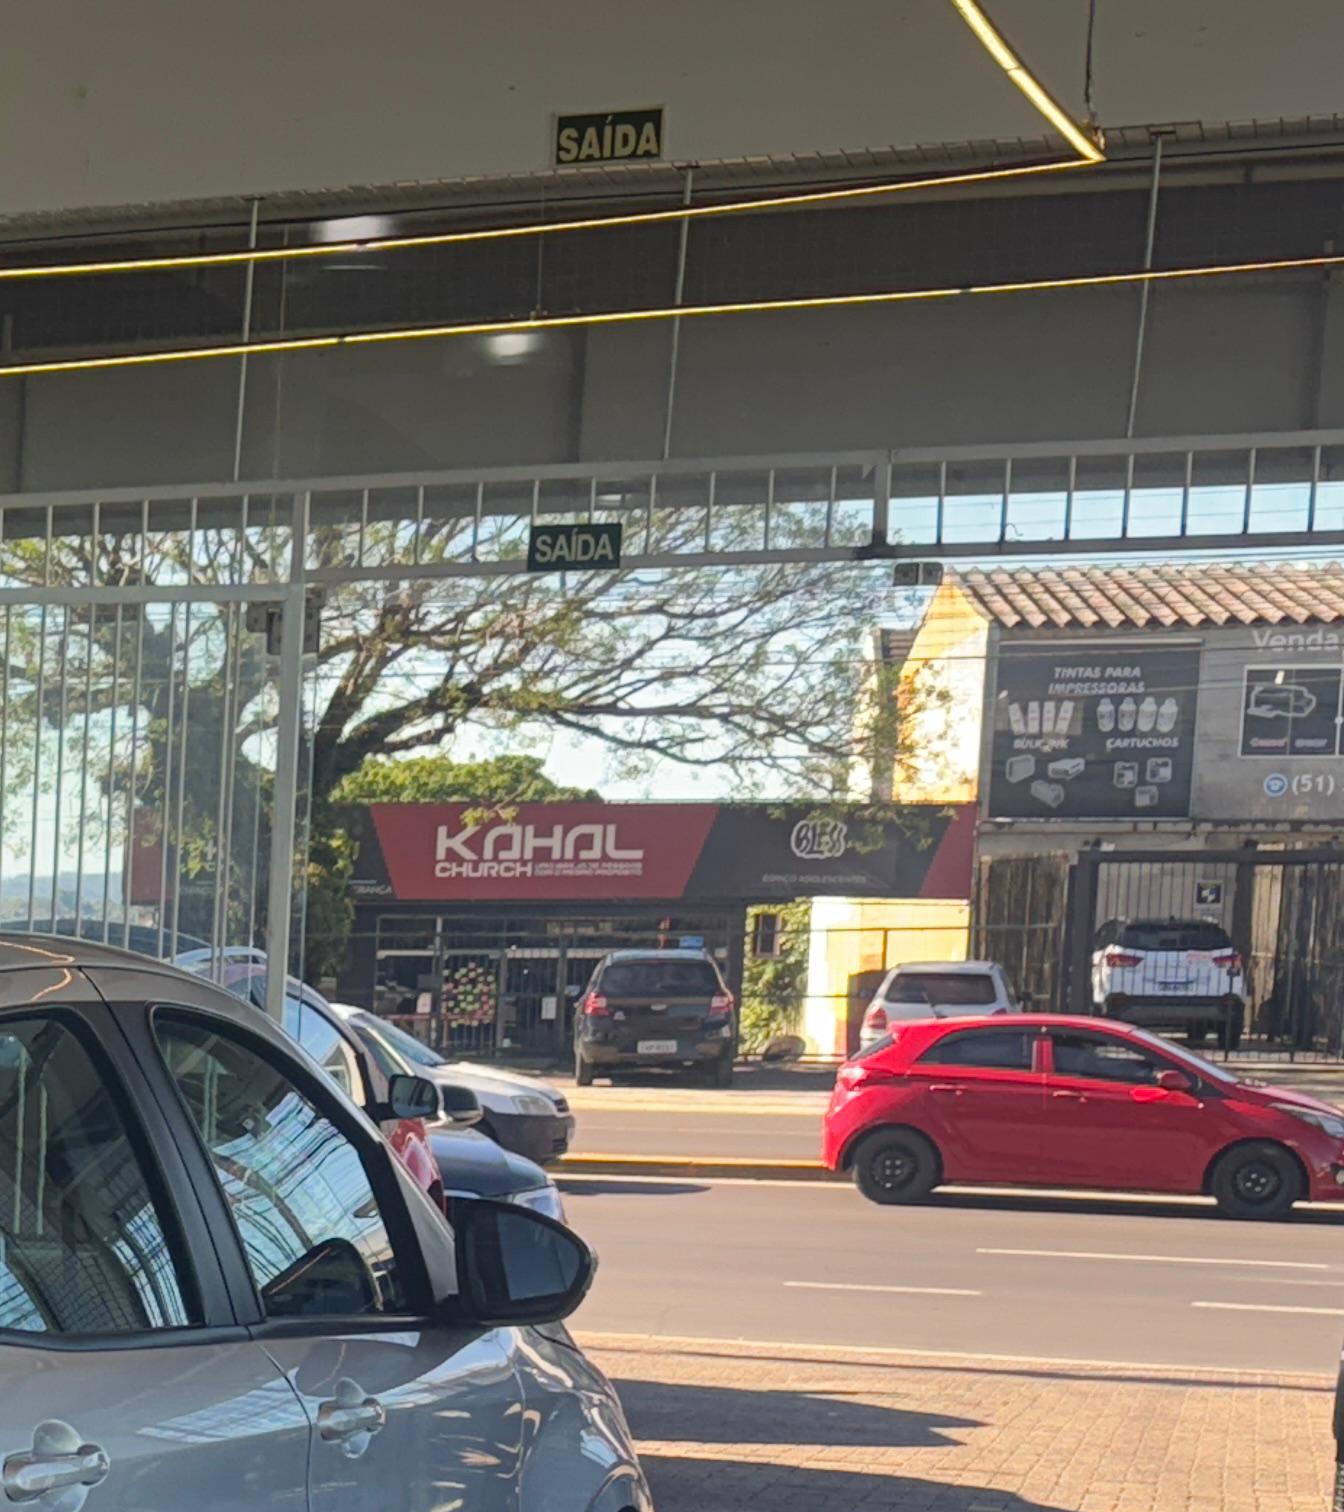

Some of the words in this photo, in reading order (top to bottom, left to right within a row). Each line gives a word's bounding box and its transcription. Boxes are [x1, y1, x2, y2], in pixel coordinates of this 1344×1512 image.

[558, 115, 660, 162] SAÍDA
[534, 527, 614, 563] SAÍDA
[1054, 666, 1102, 679] TINTAS
[1105, 666, 1141, 678] PARA
[1292, 774, 1335, 797] (51)
[435, 823, 644, 860] KAHAL
[434, 861, 533, 878] CHURCH
